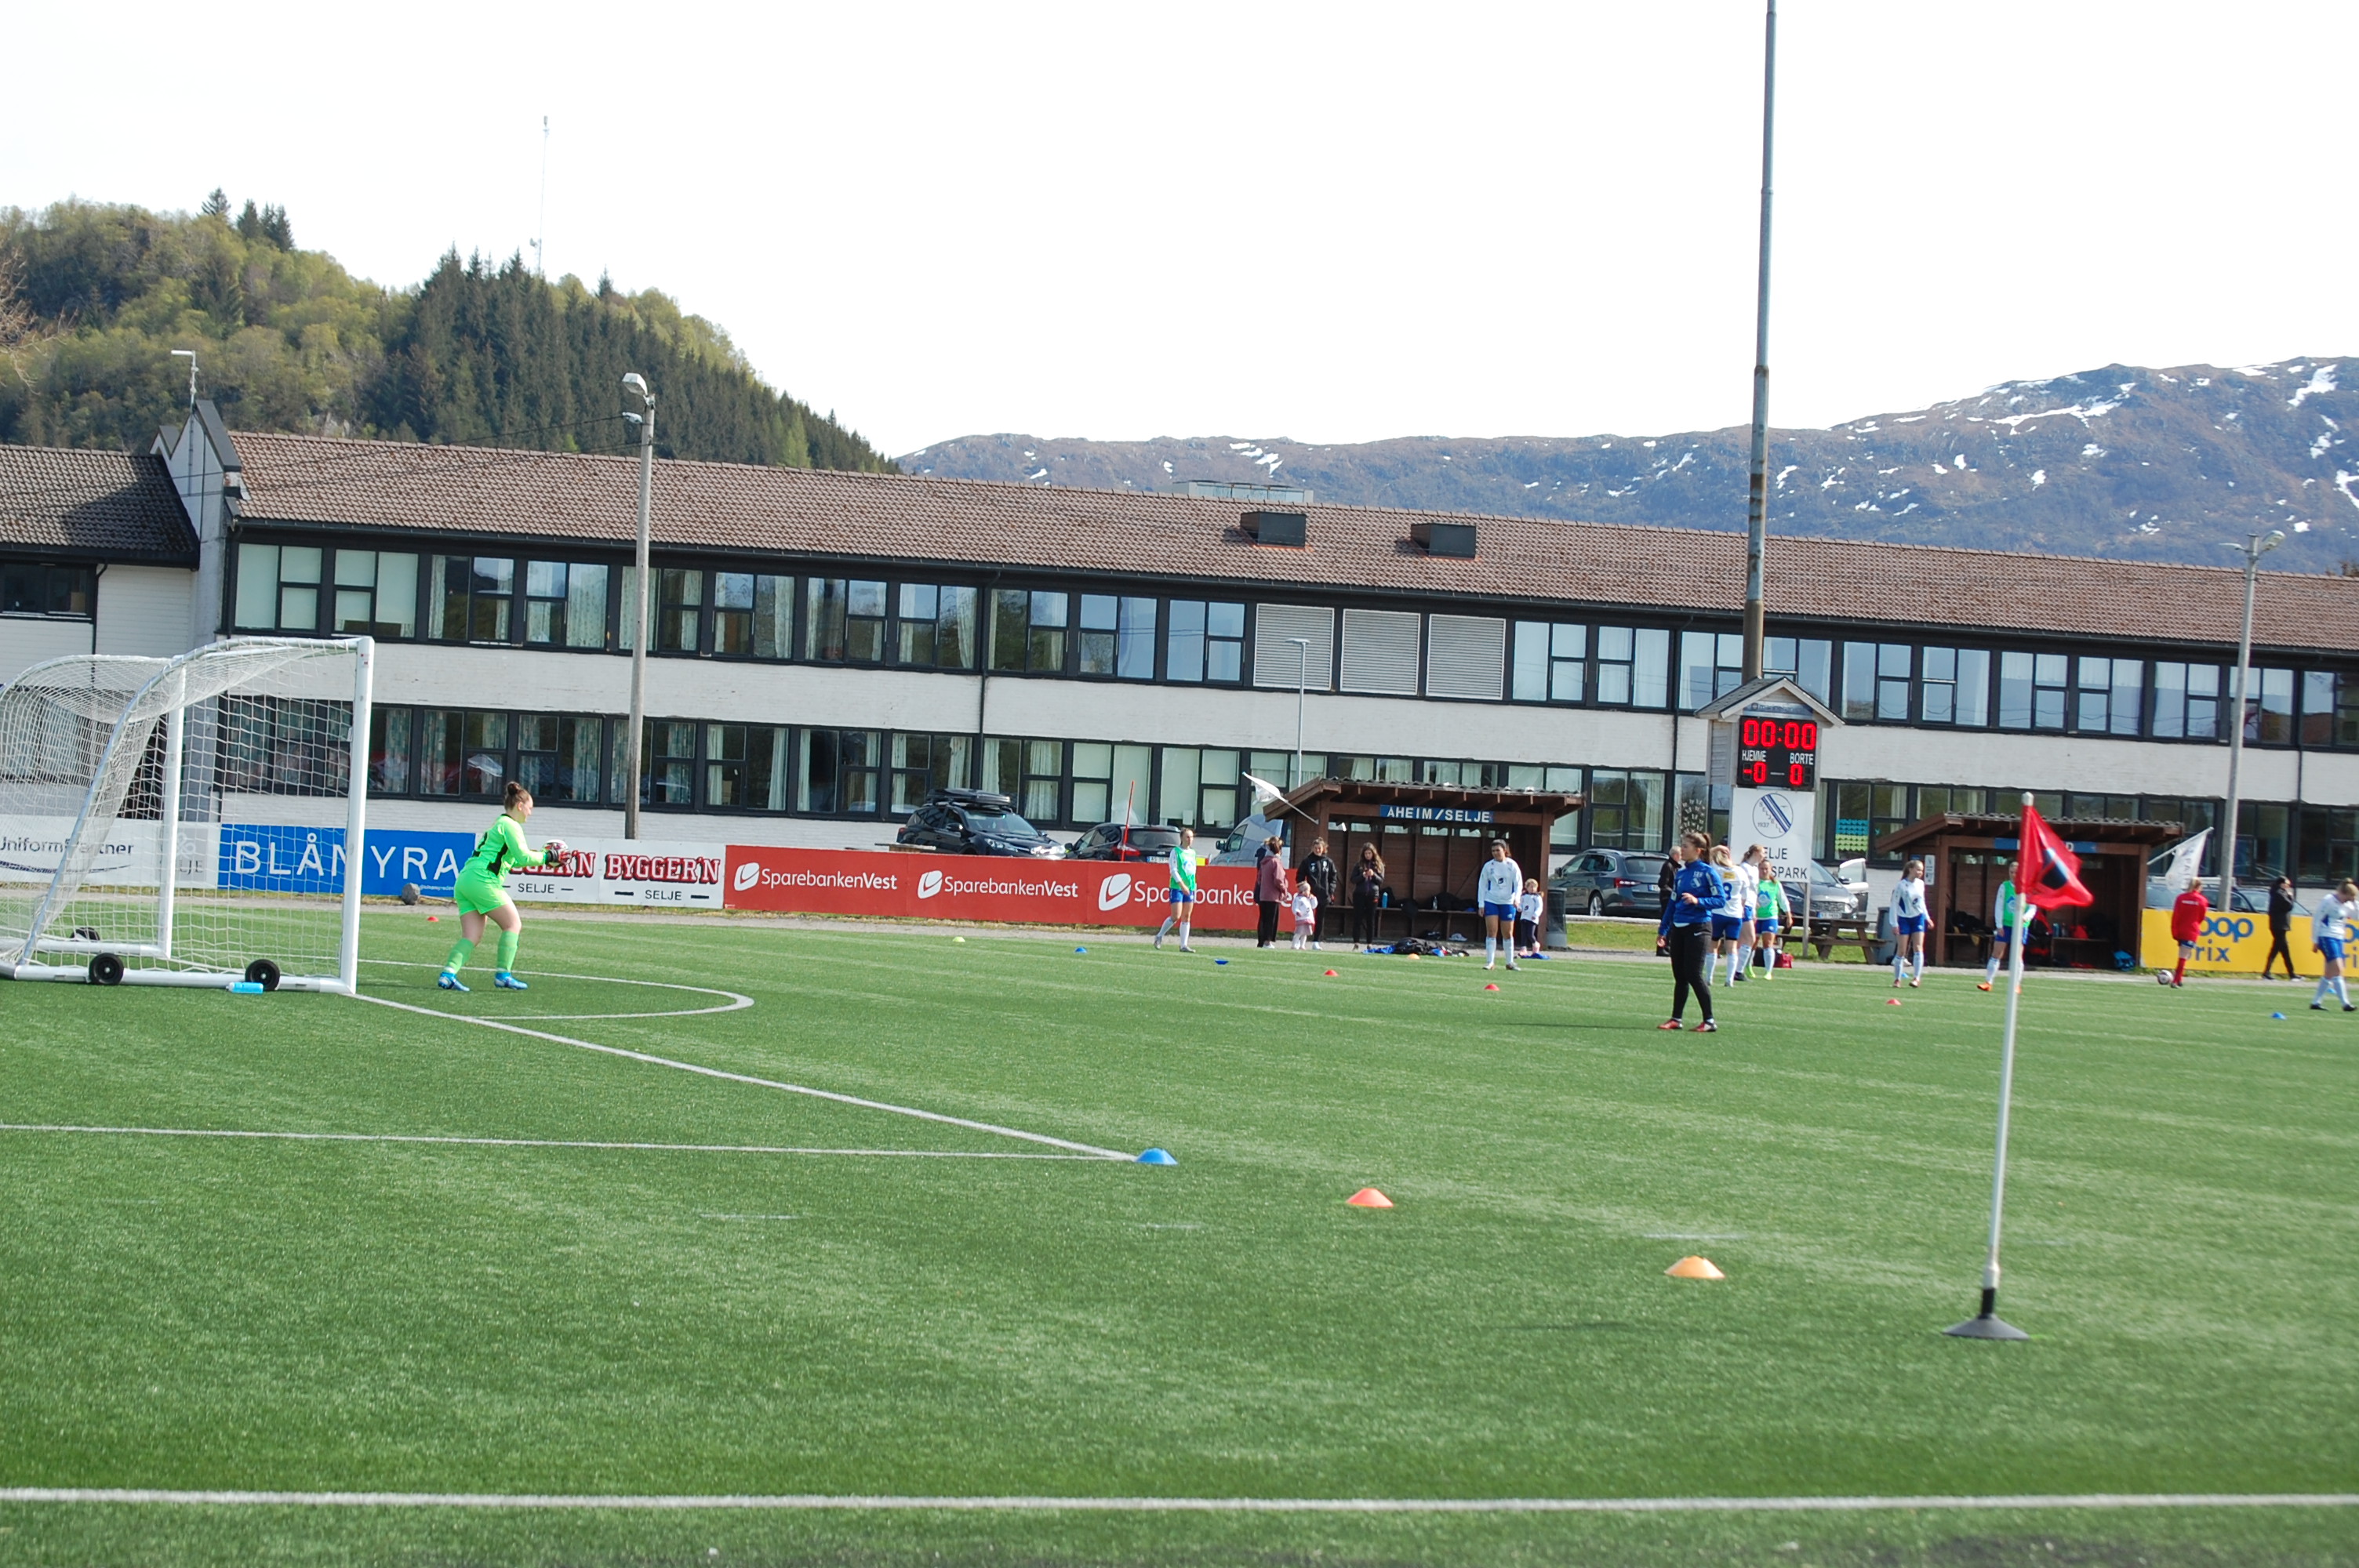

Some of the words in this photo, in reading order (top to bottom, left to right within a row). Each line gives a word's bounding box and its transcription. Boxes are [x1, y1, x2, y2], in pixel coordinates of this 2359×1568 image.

[1743, 719, 1817, 750] 00:00
[1742, 750, 1766, 762] HJEMME
[1790, 753, 1814, 765] BORTE
[0, 836, 133, 855] Uniformatner
[1764, 847, 1788, 859] ELJE
[604, 853, 721, 884] BYGGER'N
[1771, 866, 1808, 879] SPARK
[518, 882, 555, 894] SELJE
[761, 868, 897, 890] SparebankenVest
[944, 876, 1078, 898] SparebankenVest
[645, 889, 682, 901] SELJE
[2199, 916, 2254, 942] oop
[2186, 939, 2231, 963] rix
